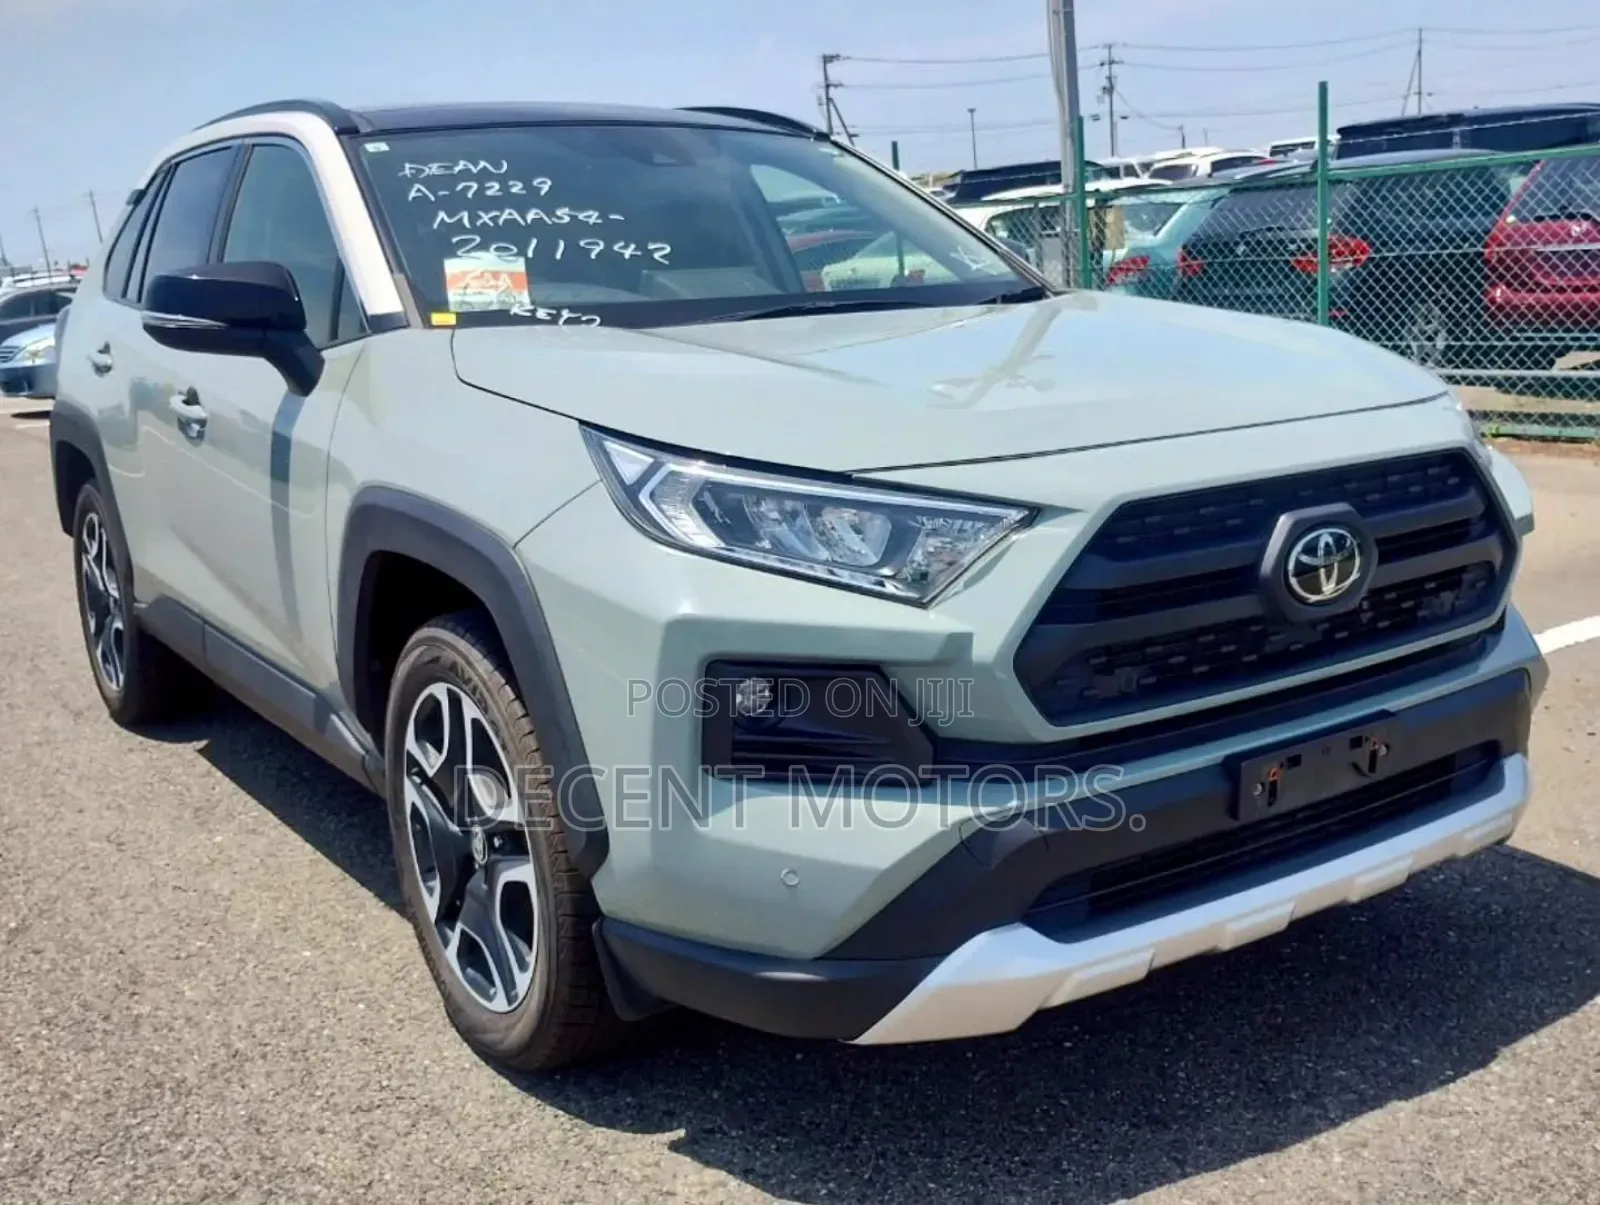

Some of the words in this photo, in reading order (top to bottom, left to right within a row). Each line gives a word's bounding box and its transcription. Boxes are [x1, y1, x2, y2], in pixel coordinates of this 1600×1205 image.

[398, 160, 508, 178] DEAN
[408, 178, 552, 202] A-7229
[451, 235, 672, 264] 2011942
